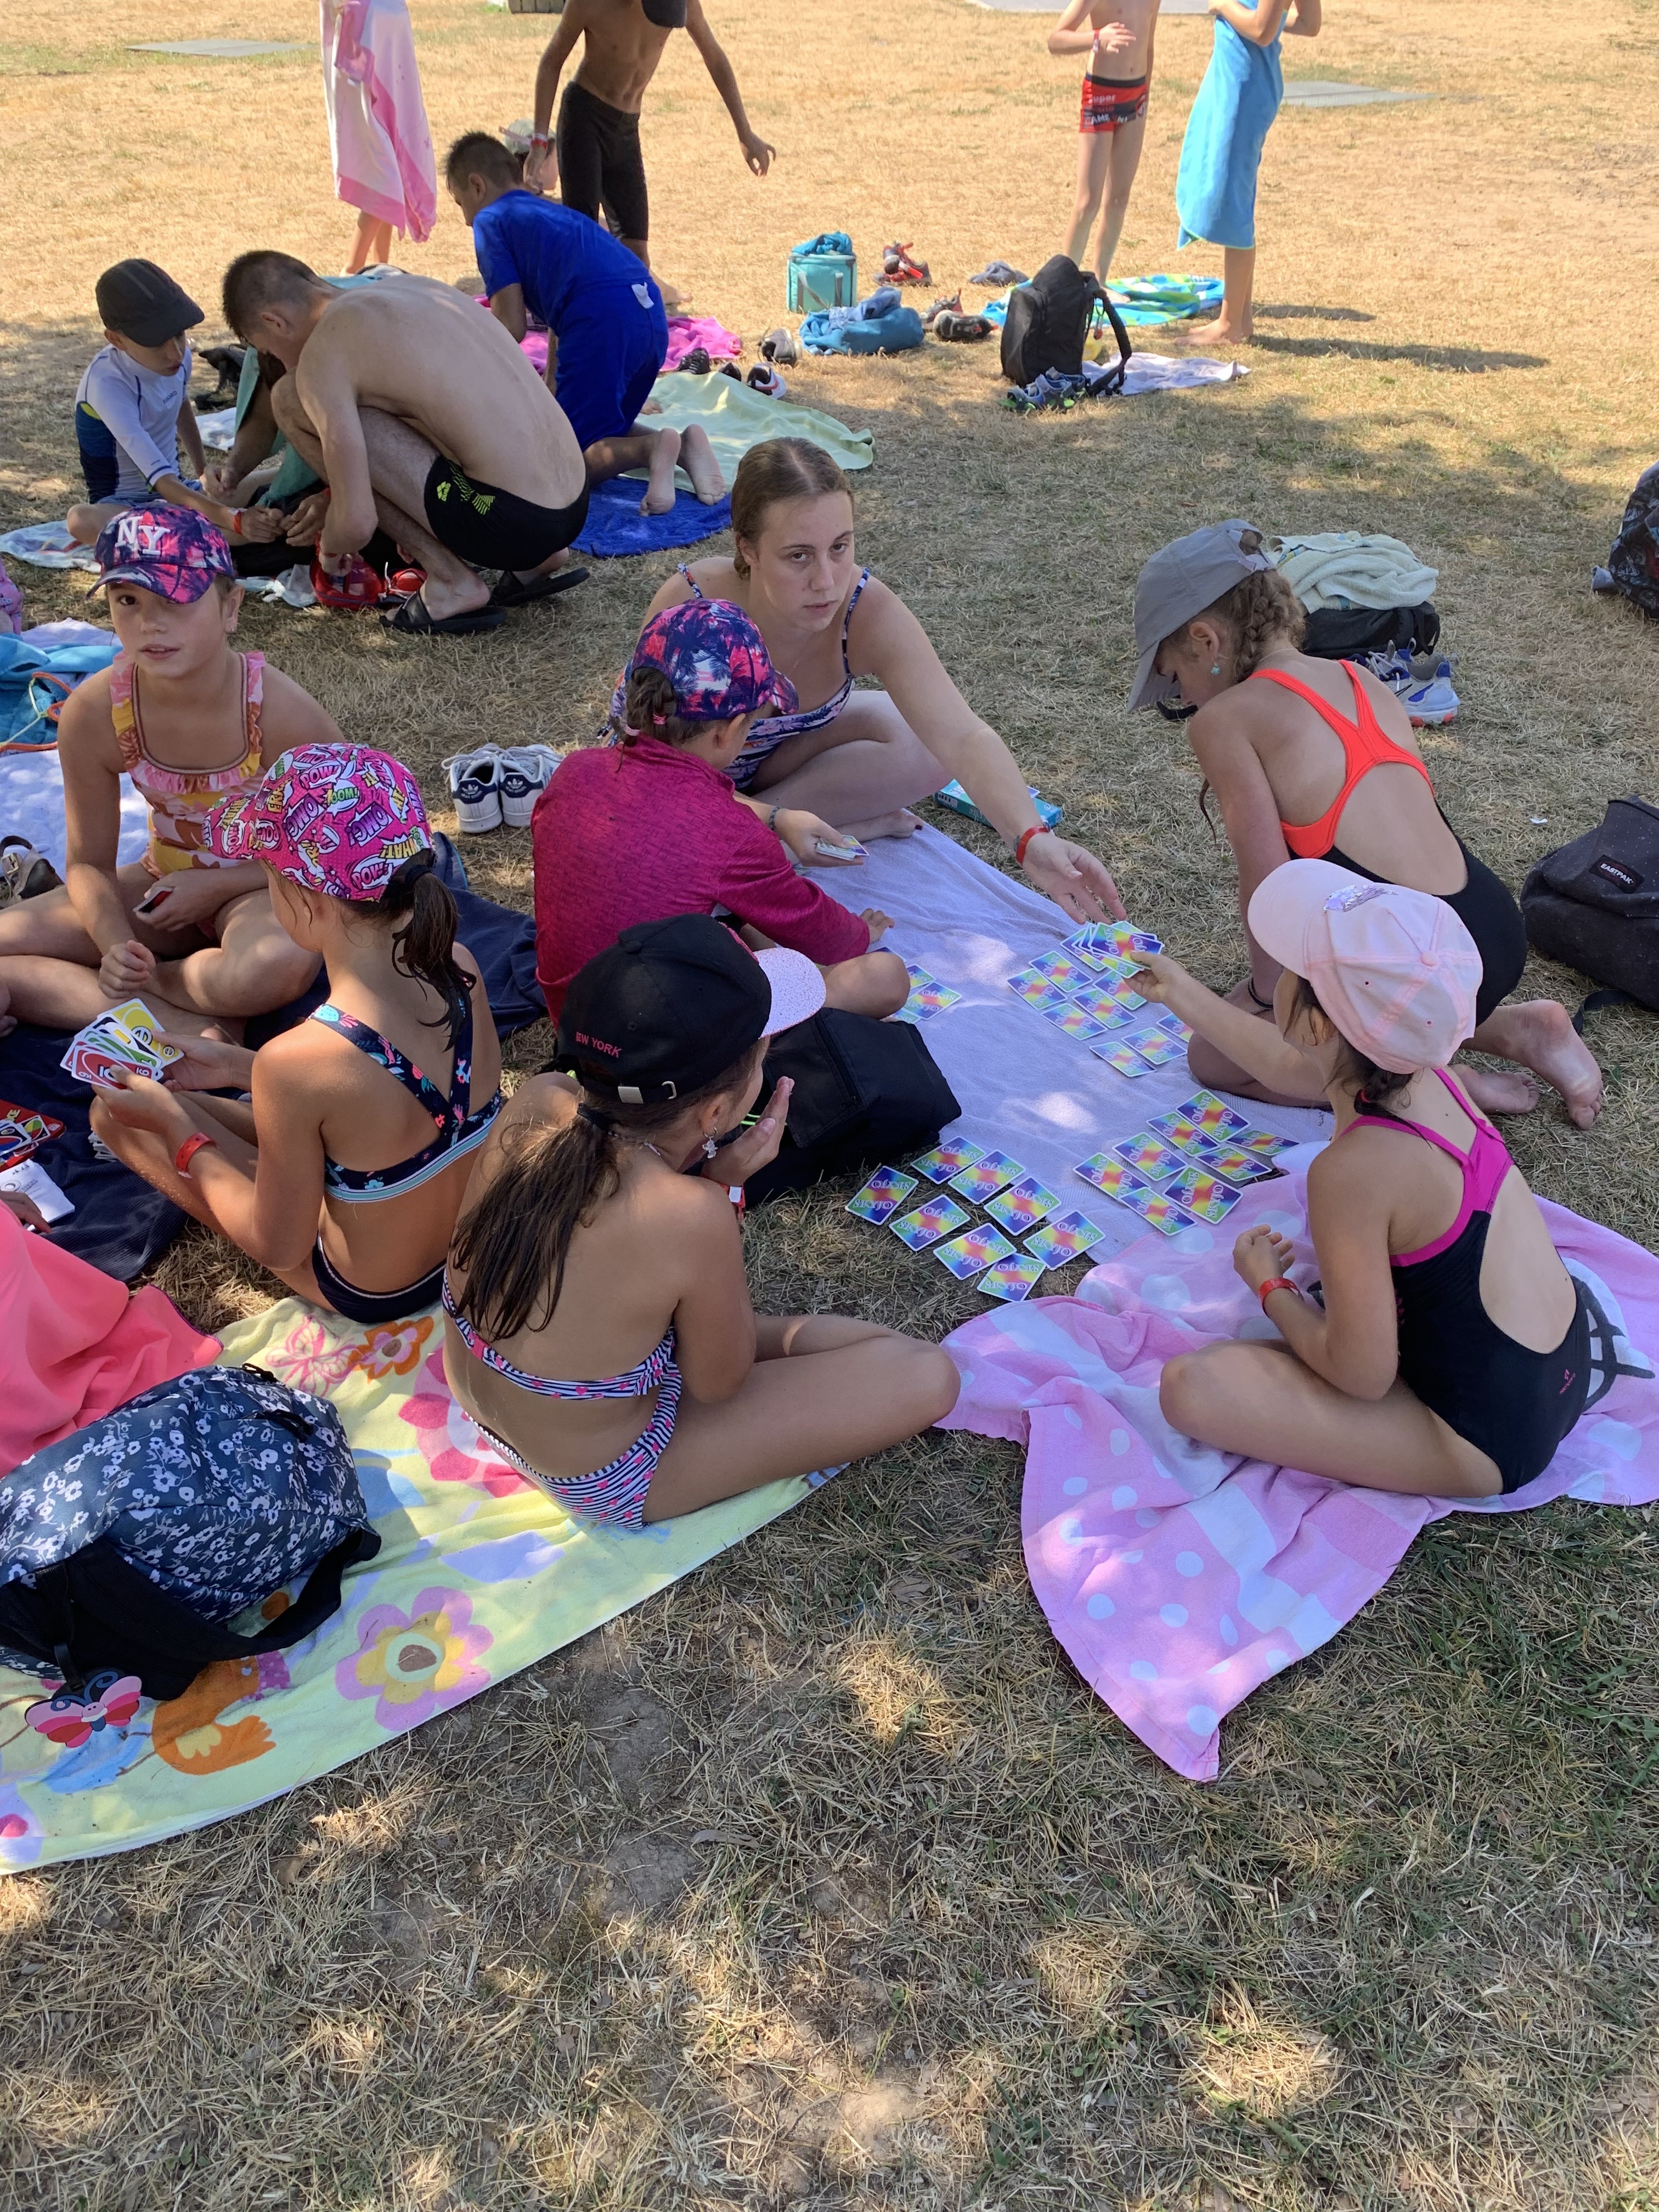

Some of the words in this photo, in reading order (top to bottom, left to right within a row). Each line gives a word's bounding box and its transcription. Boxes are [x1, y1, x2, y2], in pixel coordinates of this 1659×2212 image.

[115, 516, 171, 555] NY
[1600, 863, 1632, 884] EASTPAK
[575, 1031, 589, 1045] EW
[591, 1037, 622, 1058] YORK
